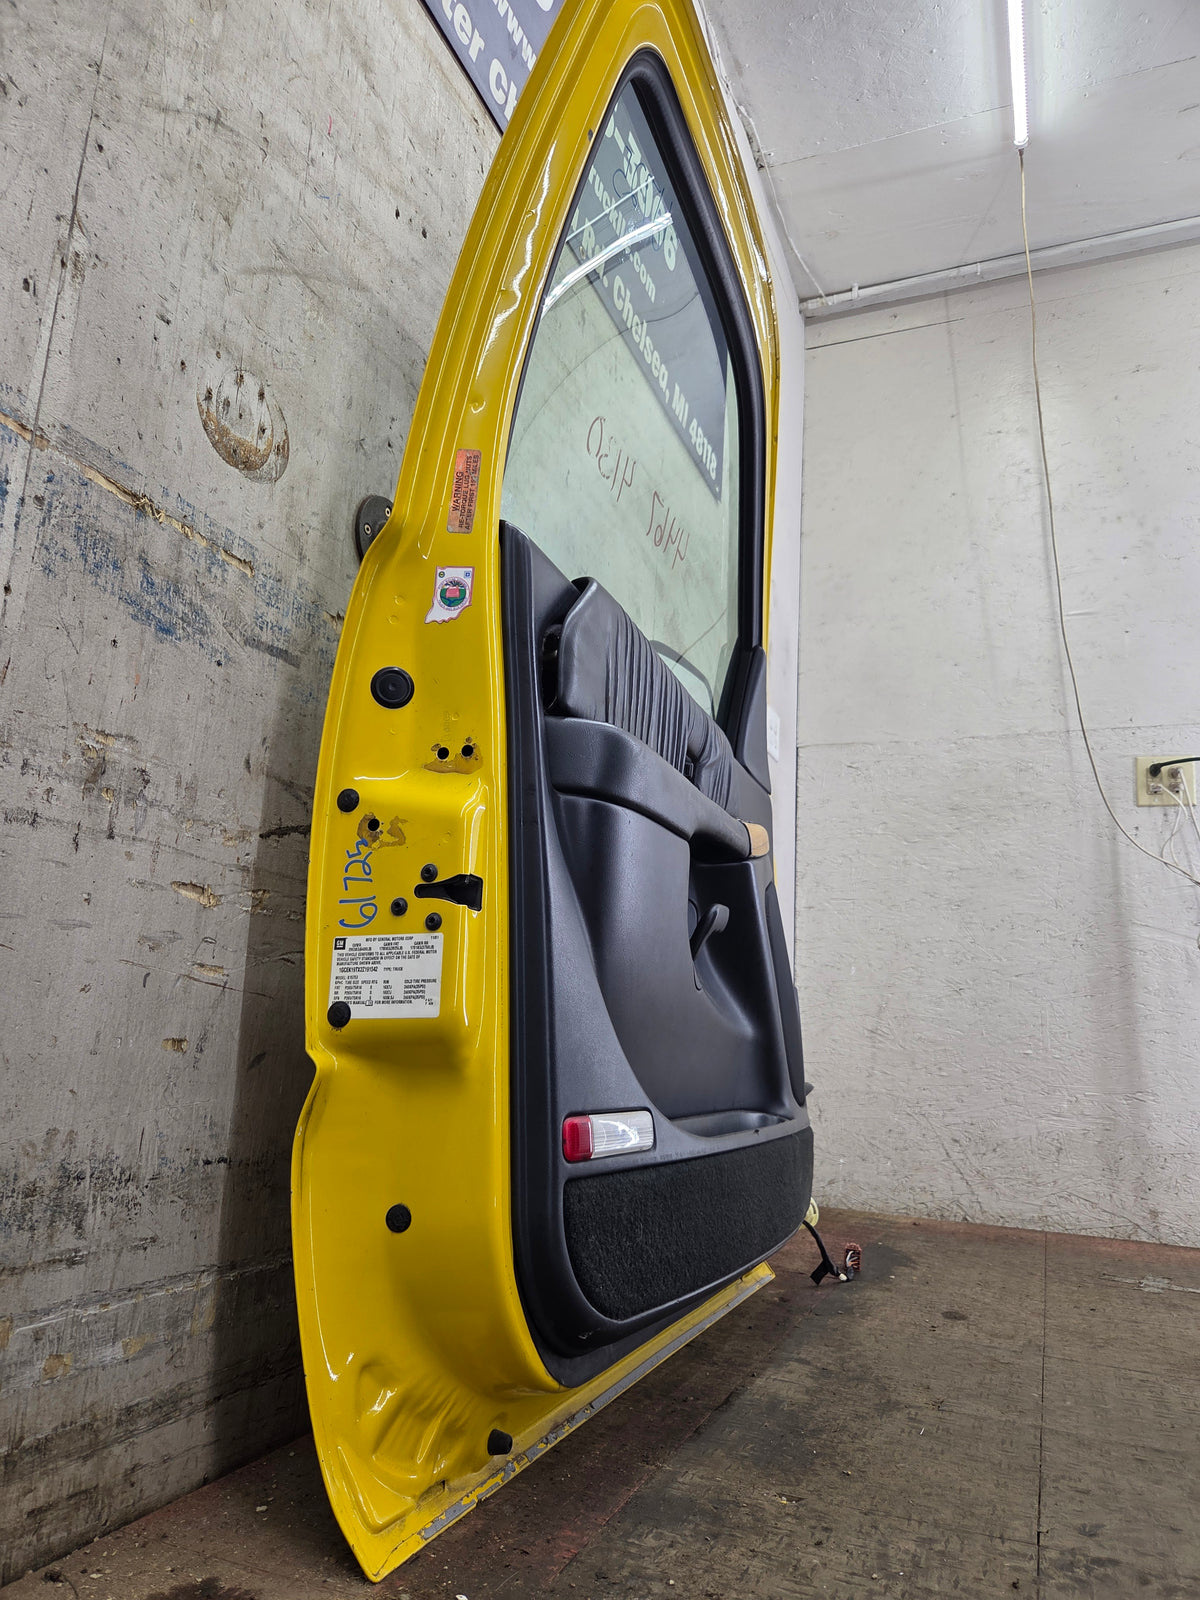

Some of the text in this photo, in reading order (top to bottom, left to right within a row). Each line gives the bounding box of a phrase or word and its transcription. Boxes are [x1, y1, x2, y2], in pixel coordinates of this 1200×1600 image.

[613, 274, 670, 404] Chelsea,
[671, 382, 690, 430] MI
[689, 417, 717, 481] 48118
[452, 471, 464, 511] WARNING
[458, 490, 468, 528] RE-TORQUE
[339, 838, 378, 929] 61725
